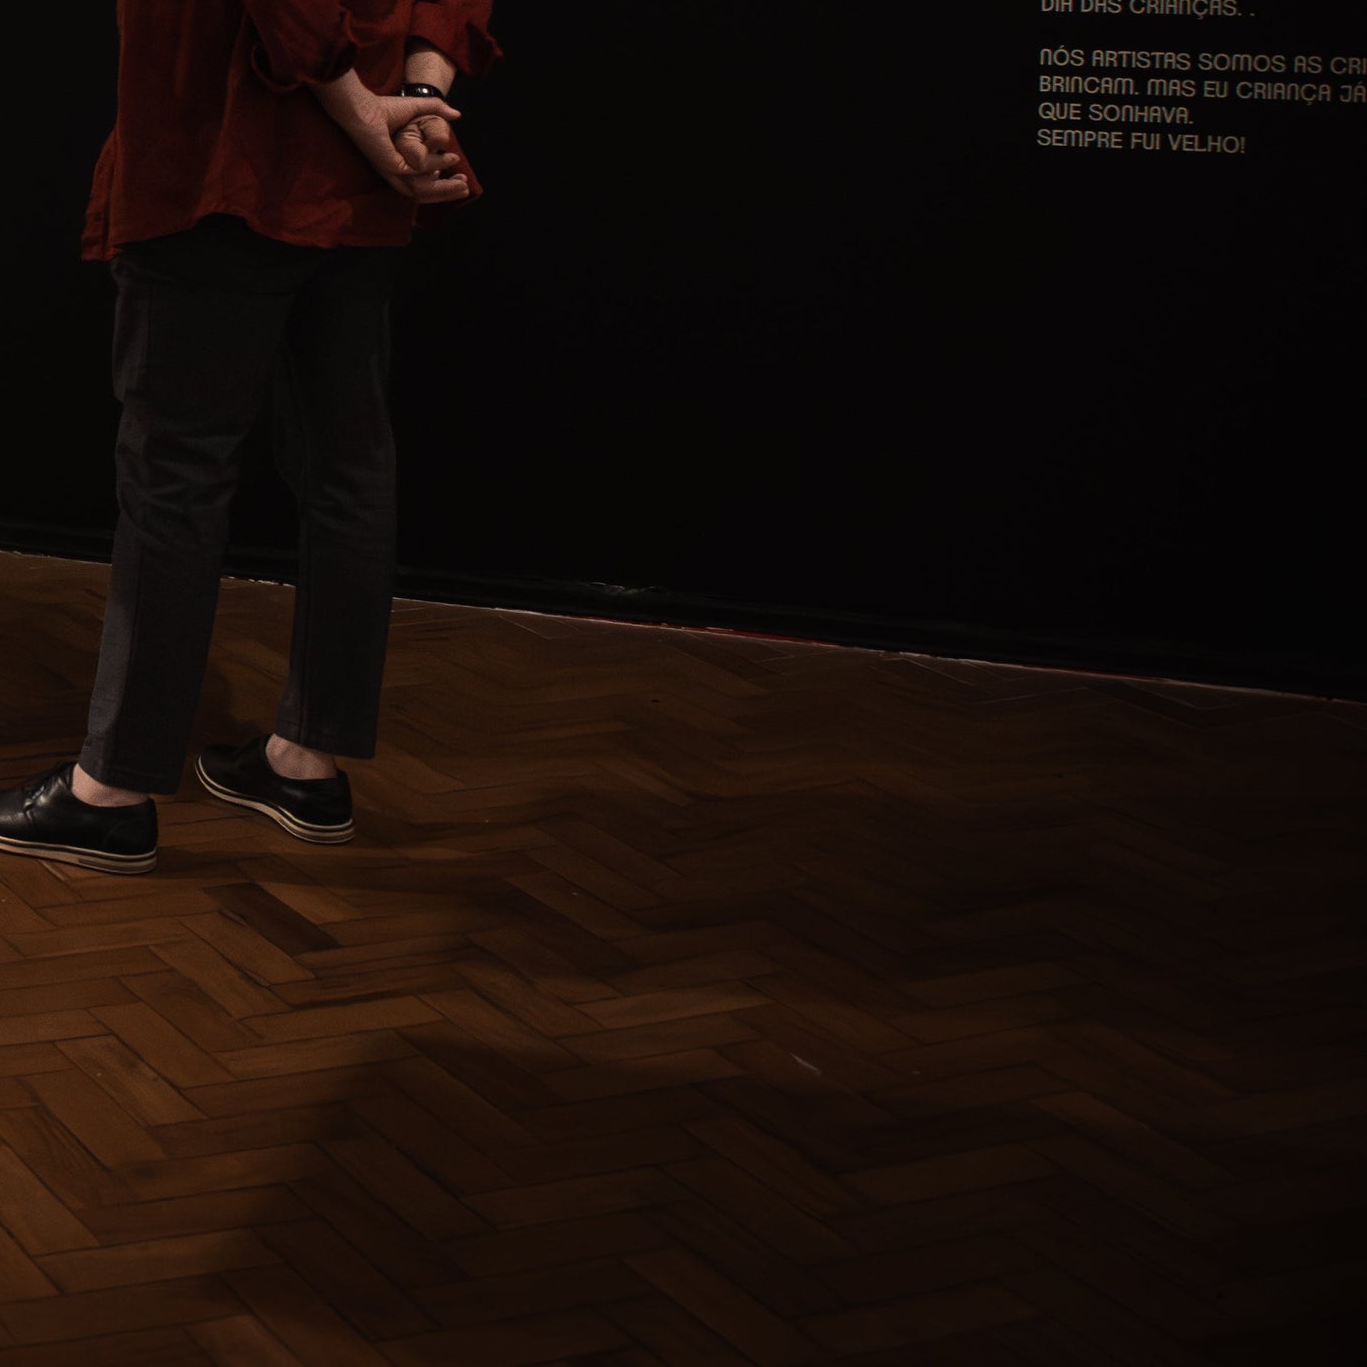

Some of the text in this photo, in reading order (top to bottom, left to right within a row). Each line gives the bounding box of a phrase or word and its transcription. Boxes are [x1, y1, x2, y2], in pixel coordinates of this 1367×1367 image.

[1040, 44, 1322, 74] NÓS ARTISTAS SOMOS AS
[1147, 78, 1196, 97] MAS
[1204, 80, 1228, 98] EU
[1236, 81, 1331, 101] CRIANÇA
[1038, 102, 1081, 121] QUE
[1037, 129, 1123, 149] SEMPRE
[1131, 132, 1161, 150] FUI
